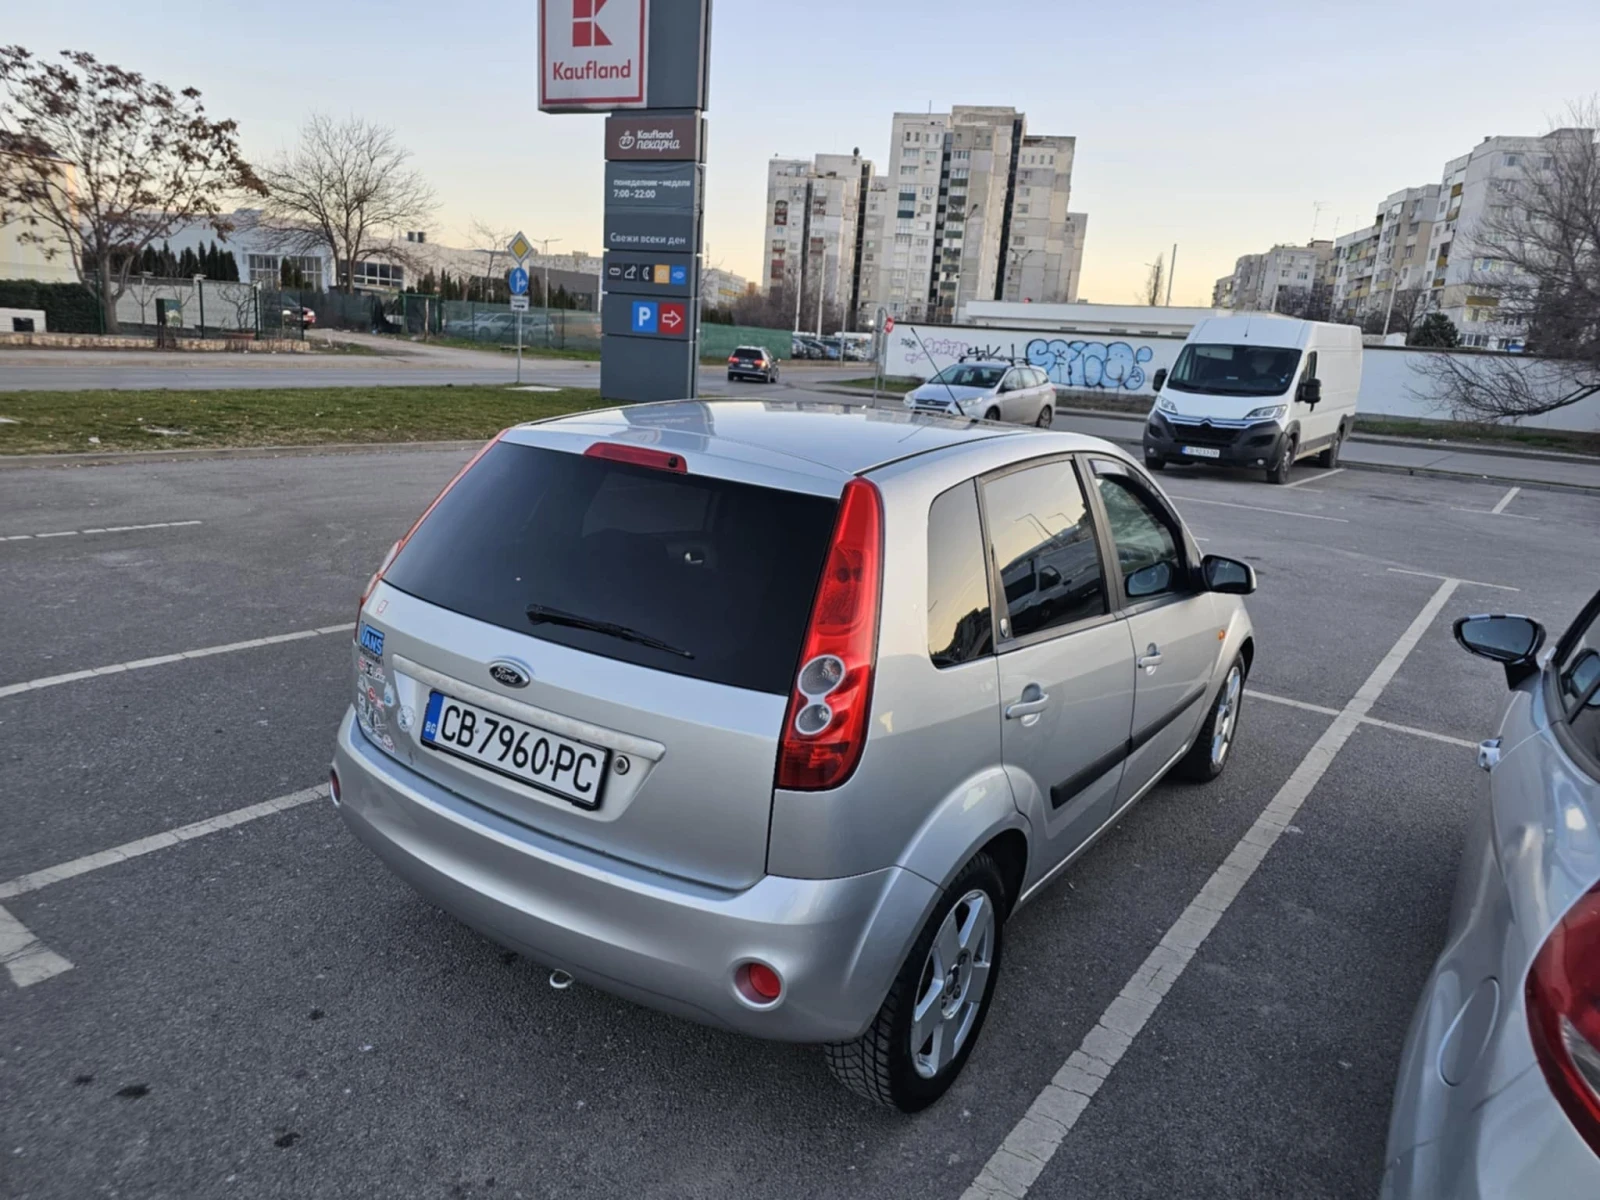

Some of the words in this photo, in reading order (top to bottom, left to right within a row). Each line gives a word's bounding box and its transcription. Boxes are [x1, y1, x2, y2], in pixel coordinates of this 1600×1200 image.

[552, 59, 631, 81] Kaufland
[637, 129, 674, 139] Kaufland
[636, 139, 681, 152] пекарна
[610, 232, 638, 243] Свежи
[640, 236, 666, 244] всеки
[667, 237, 686, 245] ден
[638, 306, 651, 327] P
[360, 622, 385, 655] VANS
[495, 667, 518, 683] Ford
[424, 721, 437, 734] BG
